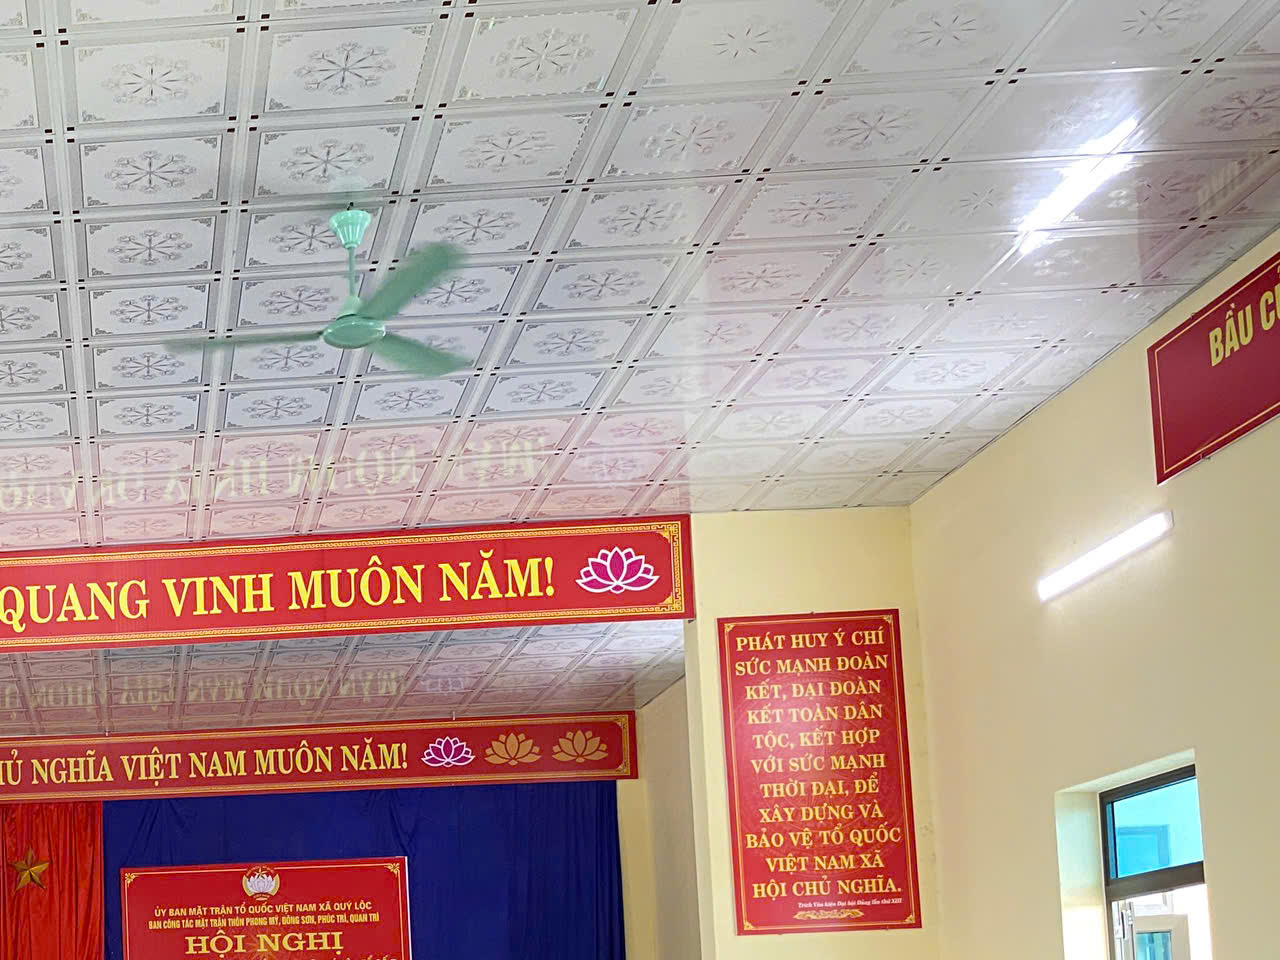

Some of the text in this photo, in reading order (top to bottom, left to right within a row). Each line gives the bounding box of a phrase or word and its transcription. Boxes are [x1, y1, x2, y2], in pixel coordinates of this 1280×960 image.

[1209, 302, 1253, 367] BẦU
[162, 574, 274, 616] VINH
[288, 555, 424, 610] MUÔN
[438, 549, 554, 601] NĂM!
[736, 626, 884, 651] PHÁT HUY Ý CHÍ
[736, 651, 888, 677] SỨC MẠNH ĐOÀN
[745, 676, 881, 702] KẾT, ĐẠI ĐOÀN
[747, 701, 882, 724] KẾT TOÀN DÂN
[752, 725, 880, 752] TỘC, KẾT HỢP
[31, 750, 114, 784] NGHĨA
[120, 746, 181, 786] VIỆT
[188, 750, 247, 777] NAM
[254, 740, 333, 775] MUÔN
[340, 737, 407, 771] NĂM!
[751, 752, 885, 773] VỚI SỨC MẠNH
[760, 772, 879, 799] THỜI ĐẠI, ĐỂ
[759, 799, 884, 825] XÂY DỰNG VÀ
[746, 822, 901, 849] BẢO VỆ TỔ QUỐC
[766, 850, 884, 875] VIỆT NAM XÃ
[752, 875, 901, 900] HỘI CHỦ NGHĨA.
[169, 908, 187, 916] BAN
[248, 902, 273, 913] QUỐC
[275, 903, 294, 915] VIỆT
[296, 904, 316, 912] NAM
[319, 901, 331, 911] XÃ
[334, 901, 352, 911] QUÝ
[355, 900, 372, 912] LỘC
[185, 929, 344, 958] HỘI NGHỊ
